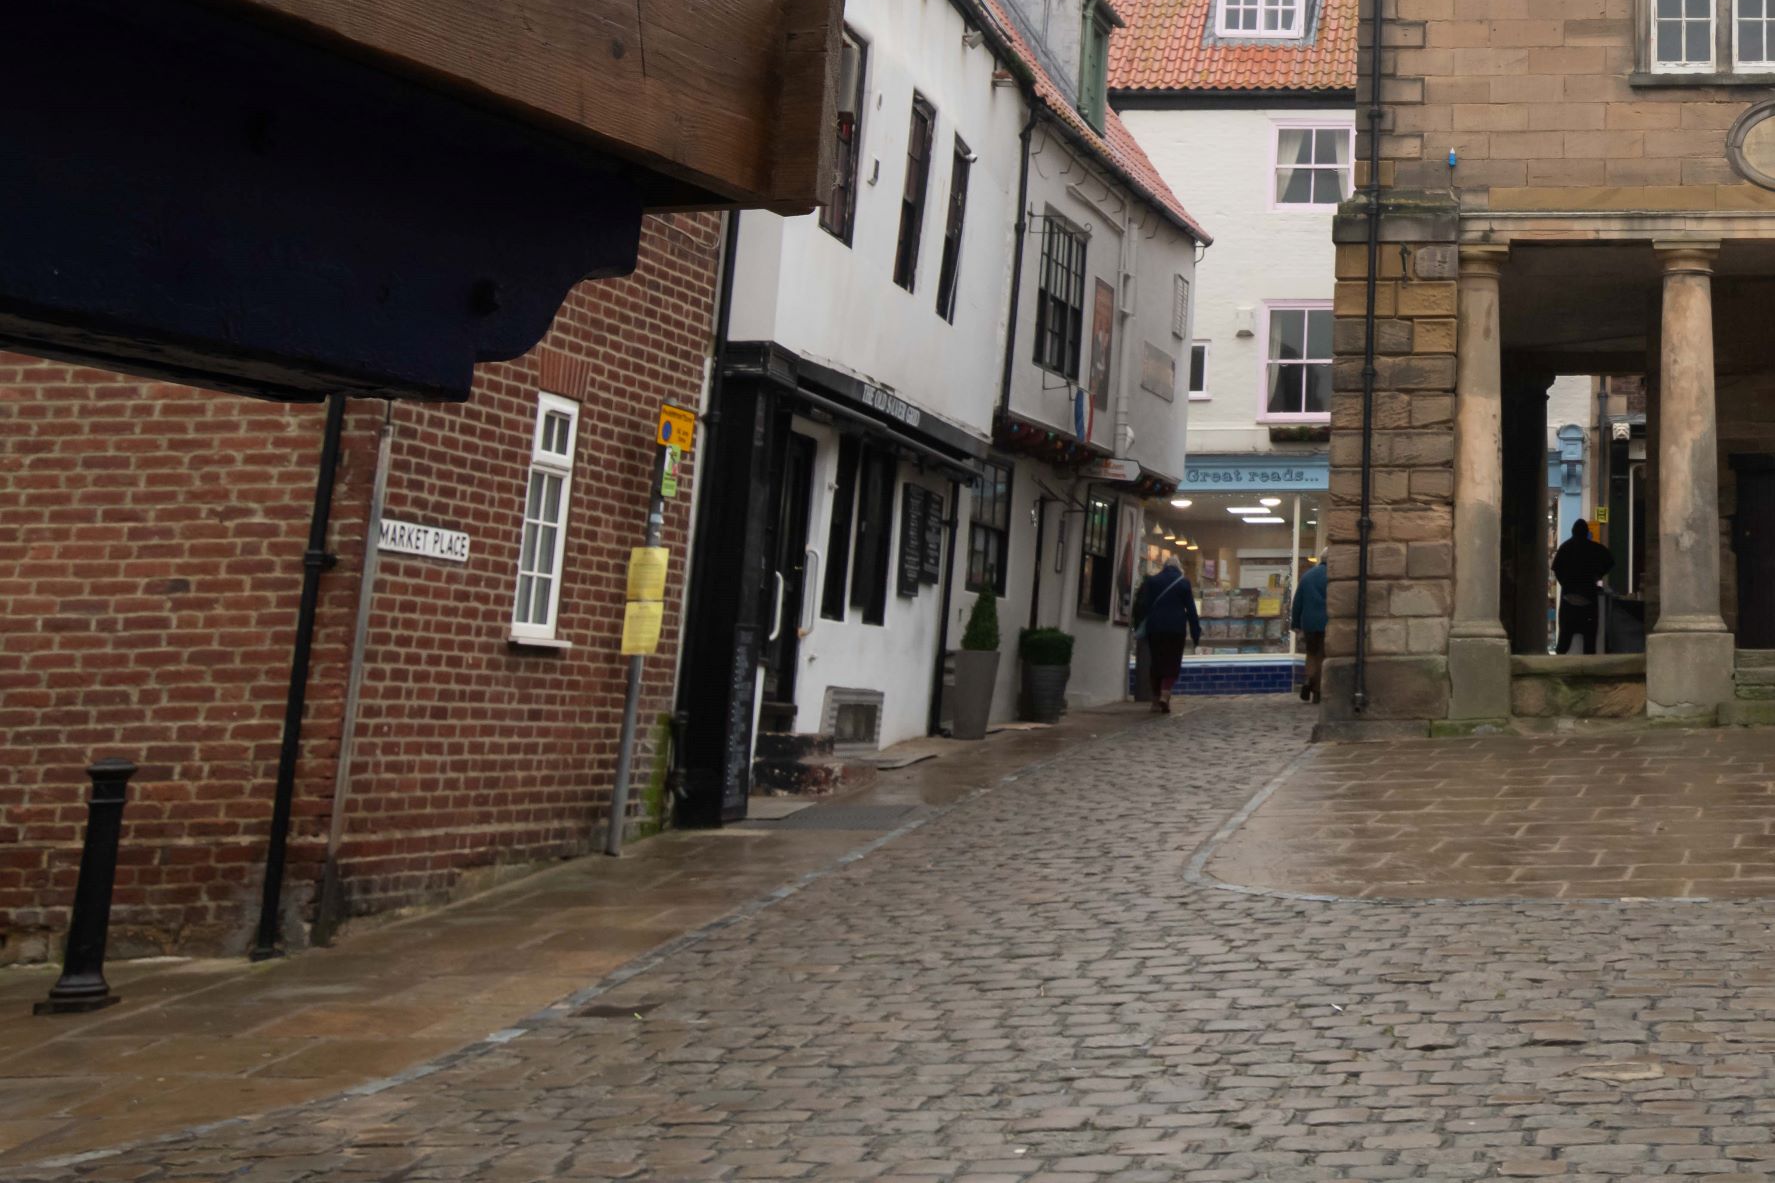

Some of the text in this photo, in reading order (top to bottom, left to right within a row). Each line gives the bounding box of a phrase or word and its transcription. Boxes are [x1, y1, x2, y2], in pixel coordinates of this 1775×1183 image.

[1186, 468, 1319, 483] Great reads...
[380, 521, 467, 557] MARKET PLACE
